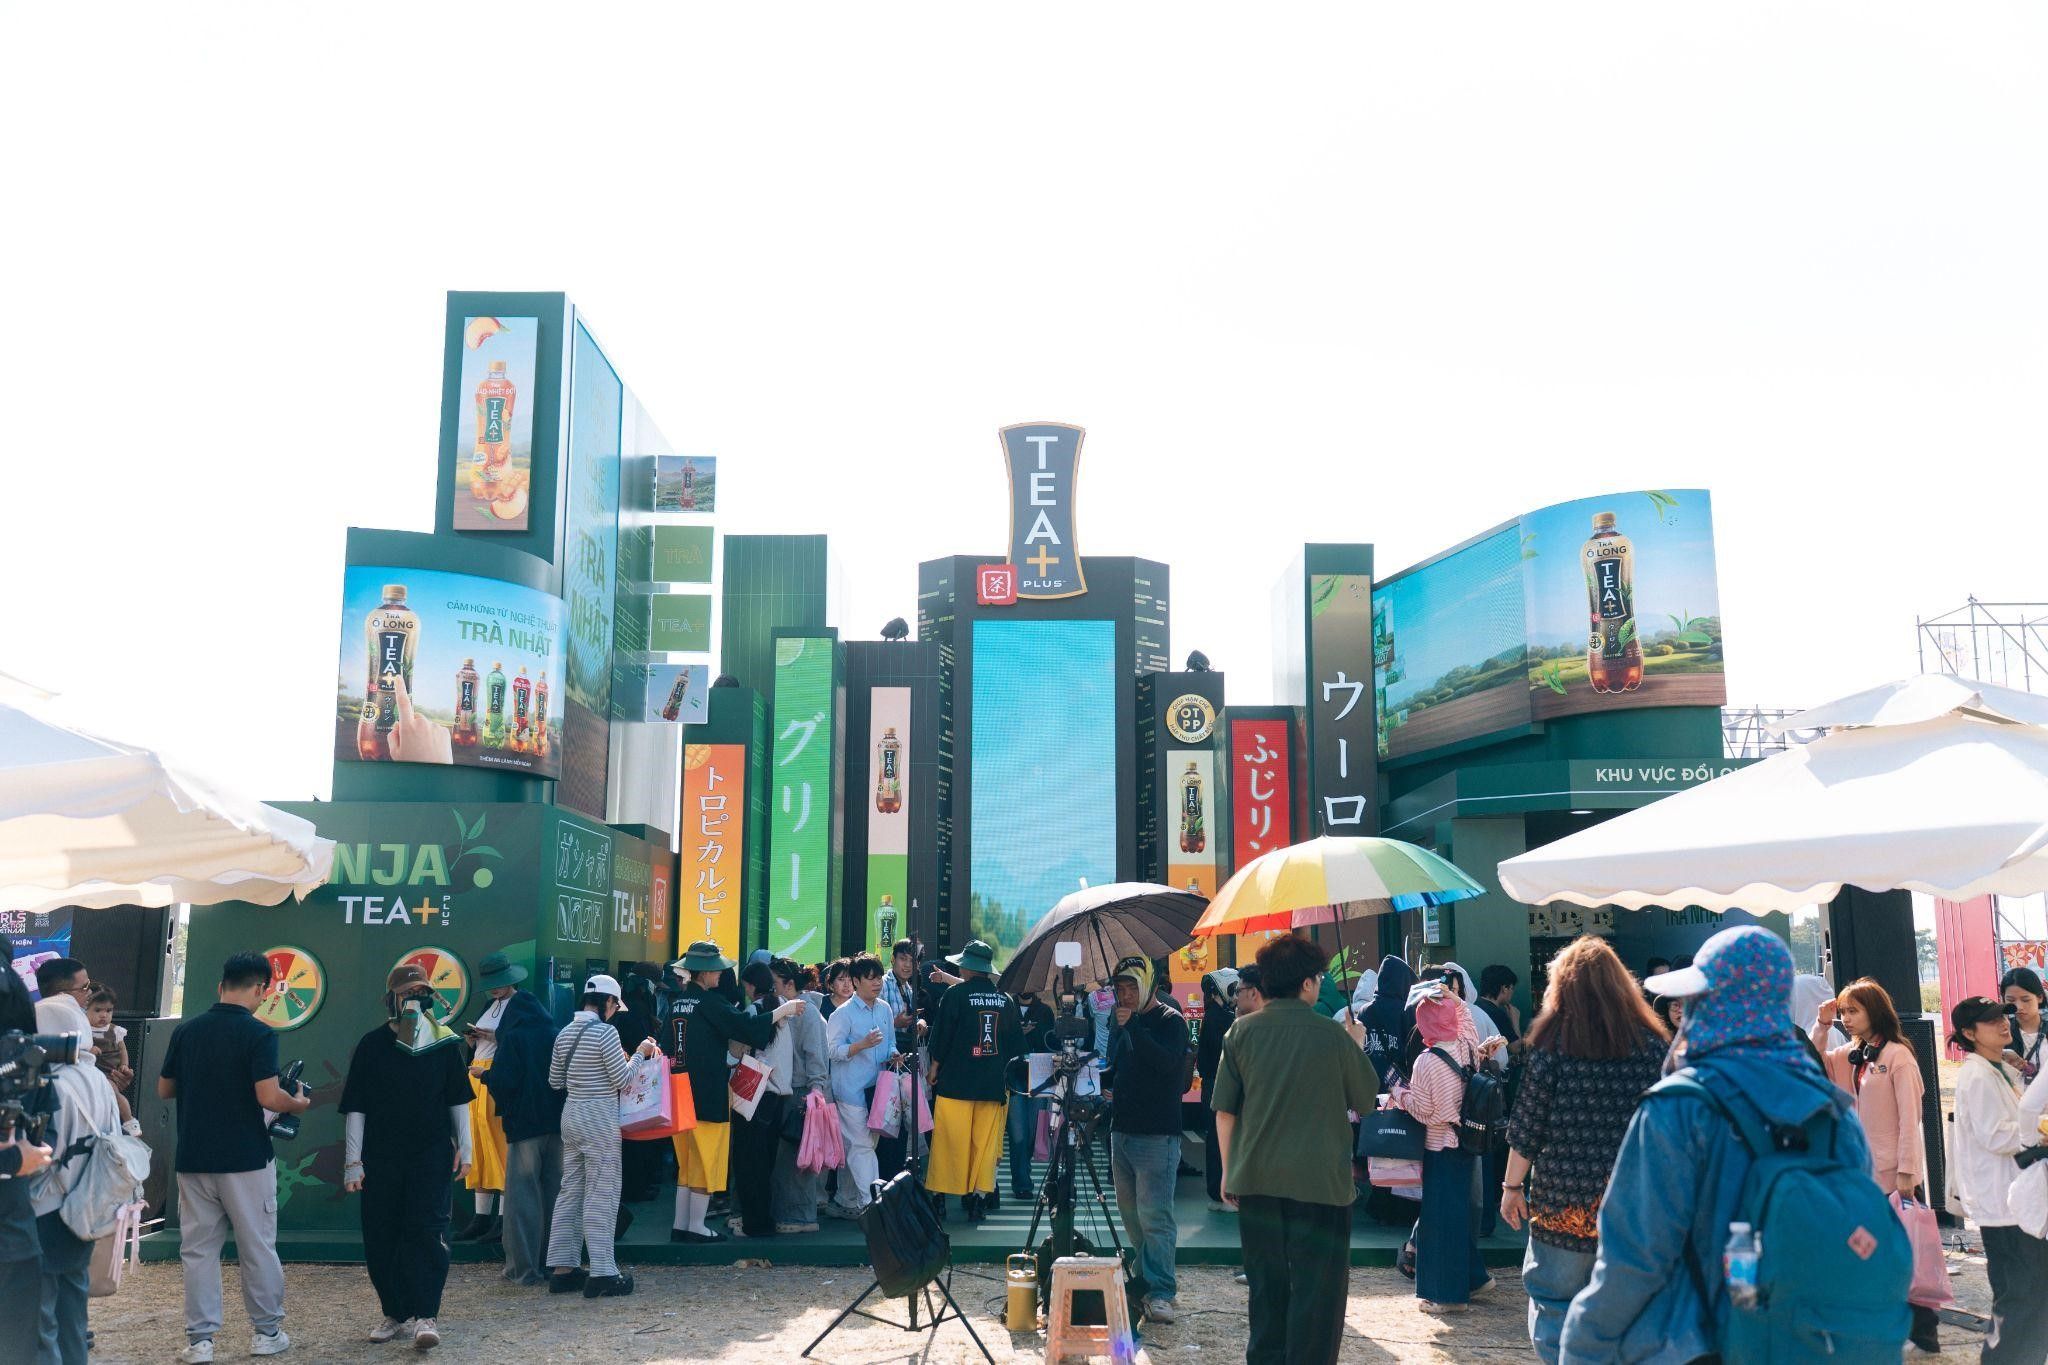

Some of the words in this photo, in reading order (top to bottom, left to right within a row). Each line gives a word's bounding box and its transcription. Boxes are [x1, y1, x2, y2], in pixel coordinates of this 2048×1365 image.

[1024, 436, 1062, 578] TEA+
[1587, 548, 1594, 558] Ô
[1597, 546, 1626, 557] LONG
[1023, 580, 1063, 588] PLUS
[1601, 562, 1616, 612] TEA+
[383, 620, 414, 629] LONG
[457, 620, 504, 646] TRÀ
[509, 628, 552, 658] NHẬT
[1182, 720, 1200, 730] PP
[1322, 671, 1366, 826] ウーロ
[1596, 768, 1633, 782] KHU
[1638, 765, 1676, 784] VỰC
[1681, 763, 1713, 781] ĐỔI
[1244, 734, 1278, 852] ふじり
[776, 712, 826, 958] グリーン
[695, 766, 729, 951] トロピカルピー
[338, 896, 440, 925] TEA+
[441, 895, 451, 926] PLUS
[613, 890, 645, 934] TEA+
[969, 997, 984, 1006] TRÀ
